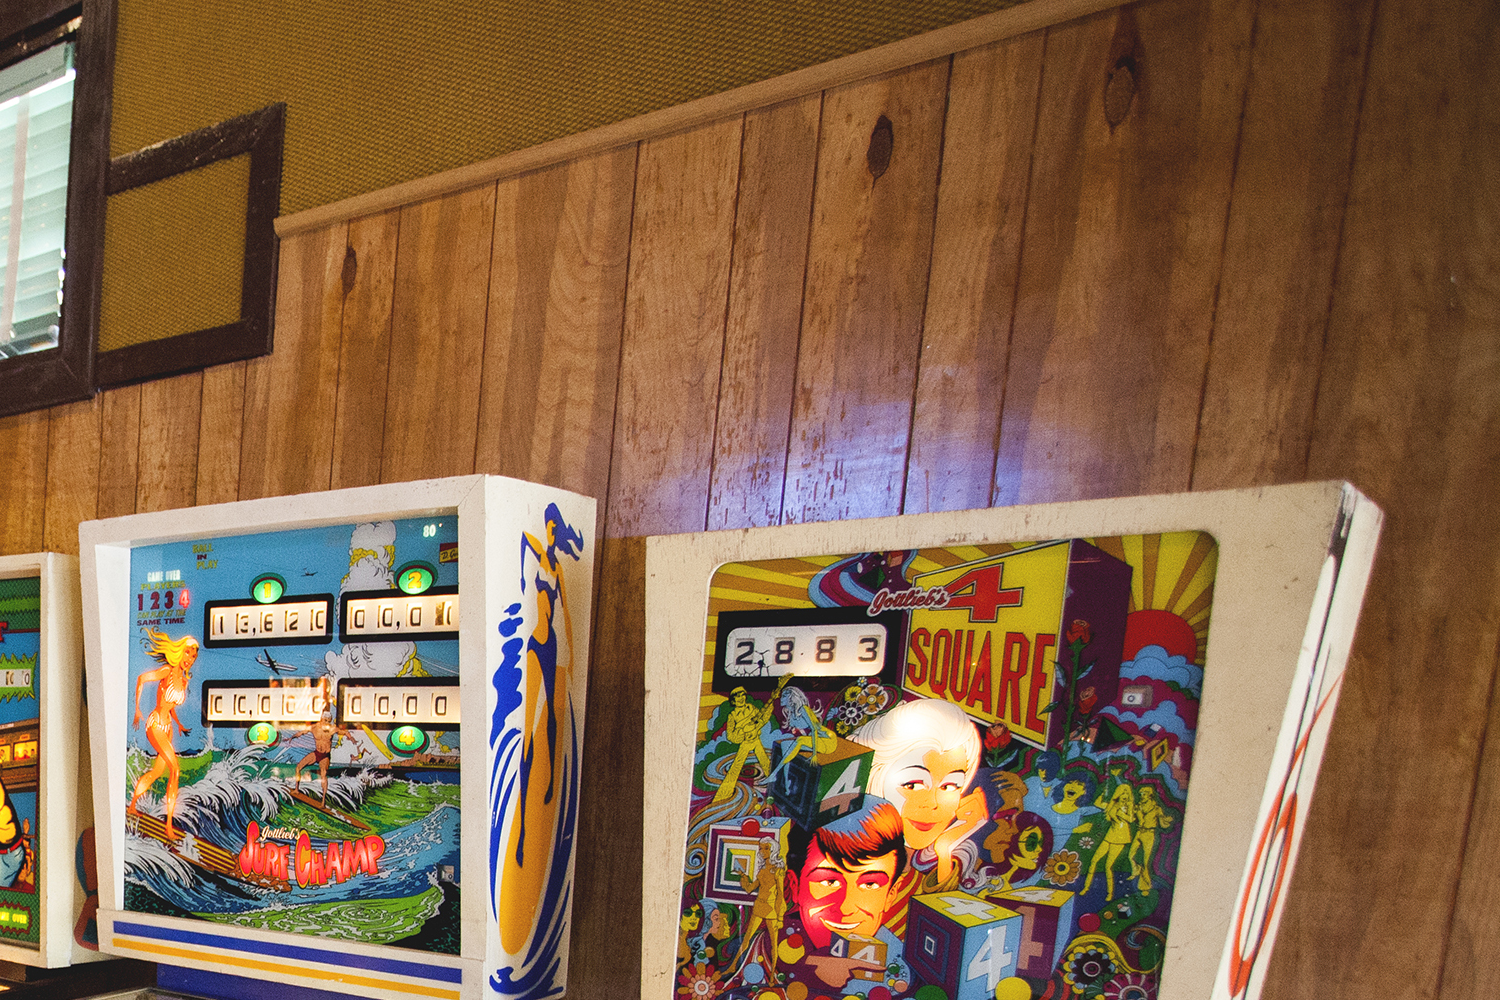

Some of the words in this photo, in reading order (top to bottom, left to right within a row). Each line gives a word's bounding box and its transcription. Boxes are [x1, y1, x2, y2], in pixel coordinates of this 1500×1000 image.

[423, 524, 436, 537] 80
[192, 544, 213, 553] BALL
[196, 560, 218, 570] PLAY
[147, 570, 164, 583] GAME
[165, 569, 181, 581] OVER
[408, 571, 422, 589] 2
[140, 580, 187, 591] PLAYERS
[262, 582, 272, 599] 1
[928, 562, 1025, 623] 4
[137, 593, 144, 611] 1
[150, 591, 160, 610] 2
[164, 590, 174, 609] 3
[178, 588, 191, 609] 4
[866, 586, 950, 616] Gottlieb's
[164, 617, 185, 625] TIME
[906, 626, 1056, 735] SQUARE
[257, 726, 269, 742] 3
[399, 730, 416, 746] 4
[819, 758, 861, 815] 4
[260, 825, 301, 842] Gottlieb's
[239, 820, 290, 881] SURF
[294, 828, 386, 889] CHAMP
[967, 924, 1012, 993] 4
